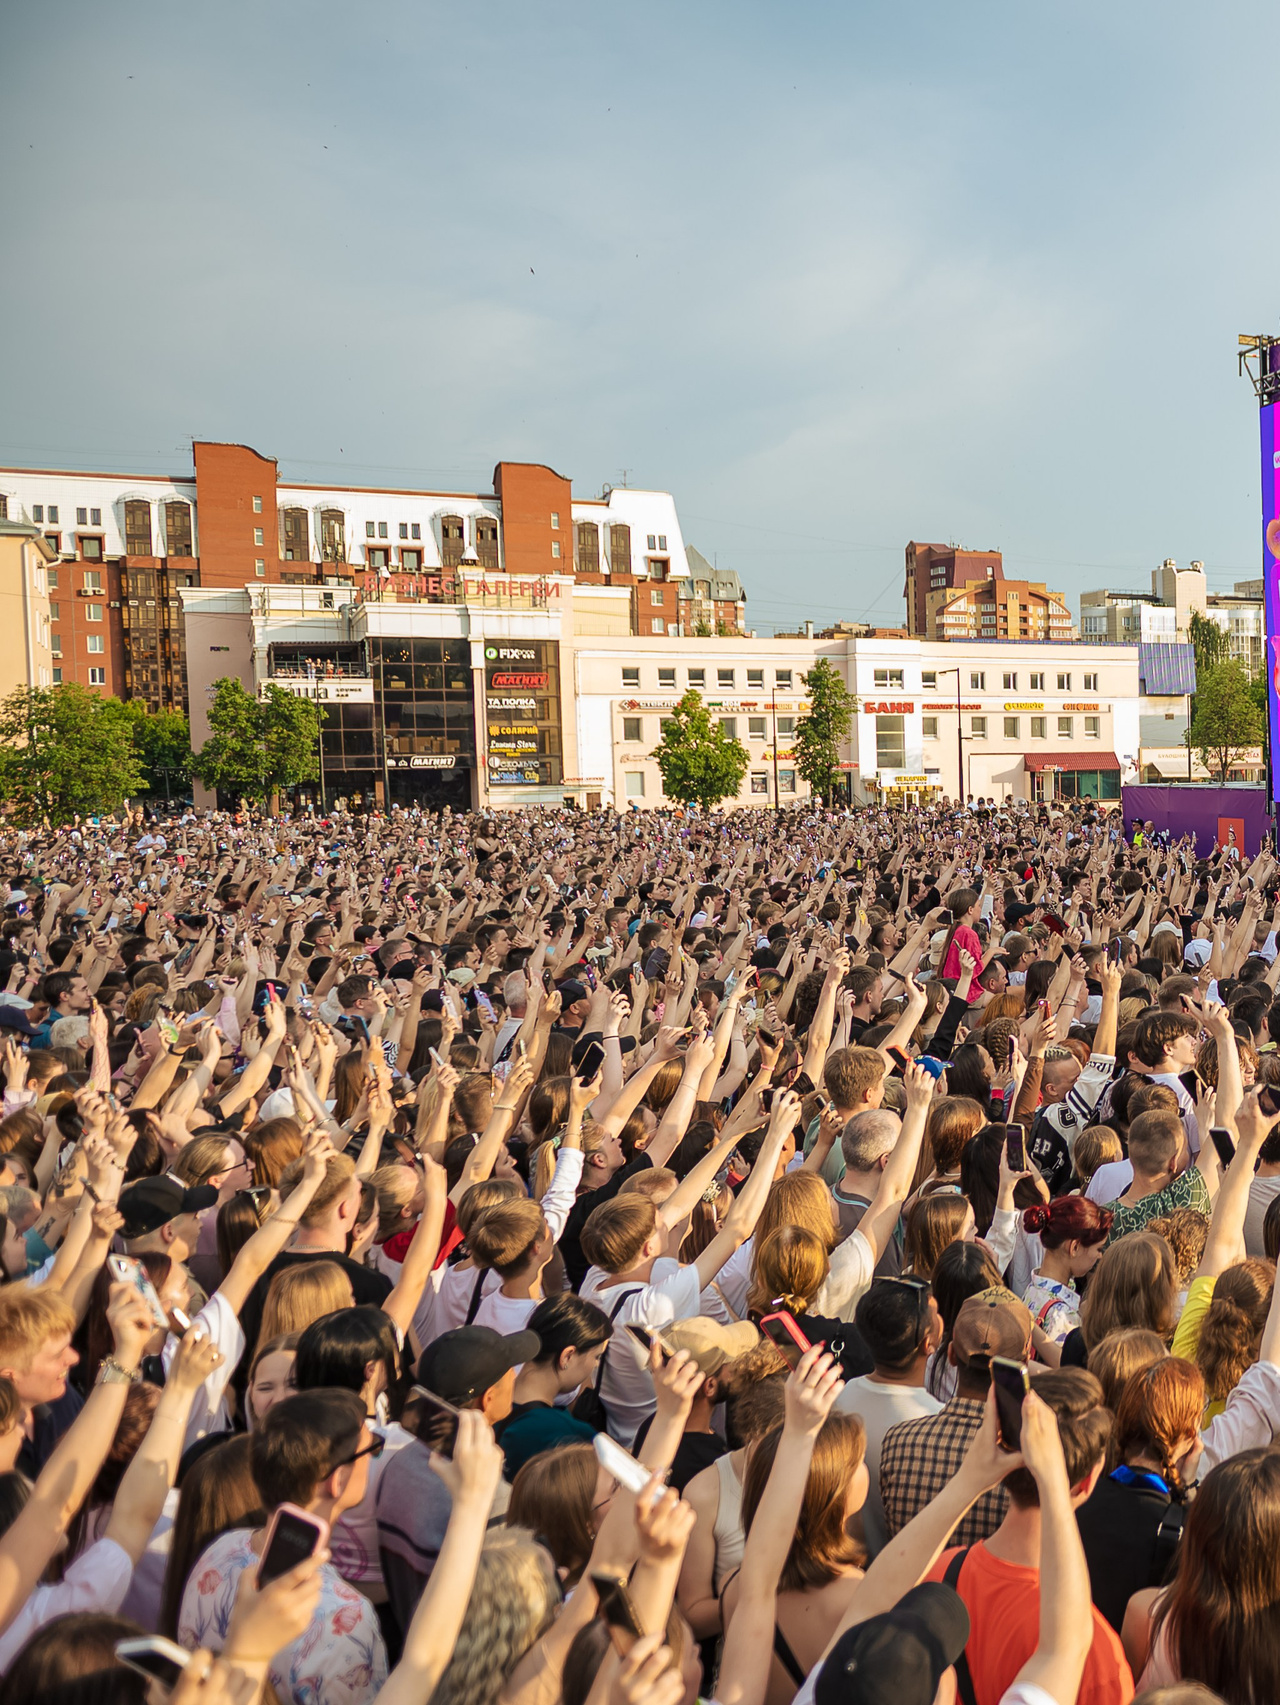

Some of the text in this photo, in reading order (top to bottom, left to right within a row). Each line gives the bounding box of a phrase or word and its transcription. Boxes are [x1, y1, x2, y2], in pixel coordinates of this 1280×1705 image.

[364, 575, 560, 598] БИЗНЕС ГАЛЕРЕИ
[496, 674, 548, 685] МАГНИТ
[487, 698, 536, 706] ТА ПОЛКА
[863, 702, 894, 714] БАНЯ
[500, 725, 539, 735] СОЛЯРИЙ
[413, 758, 453, 766] МАГНИТ
